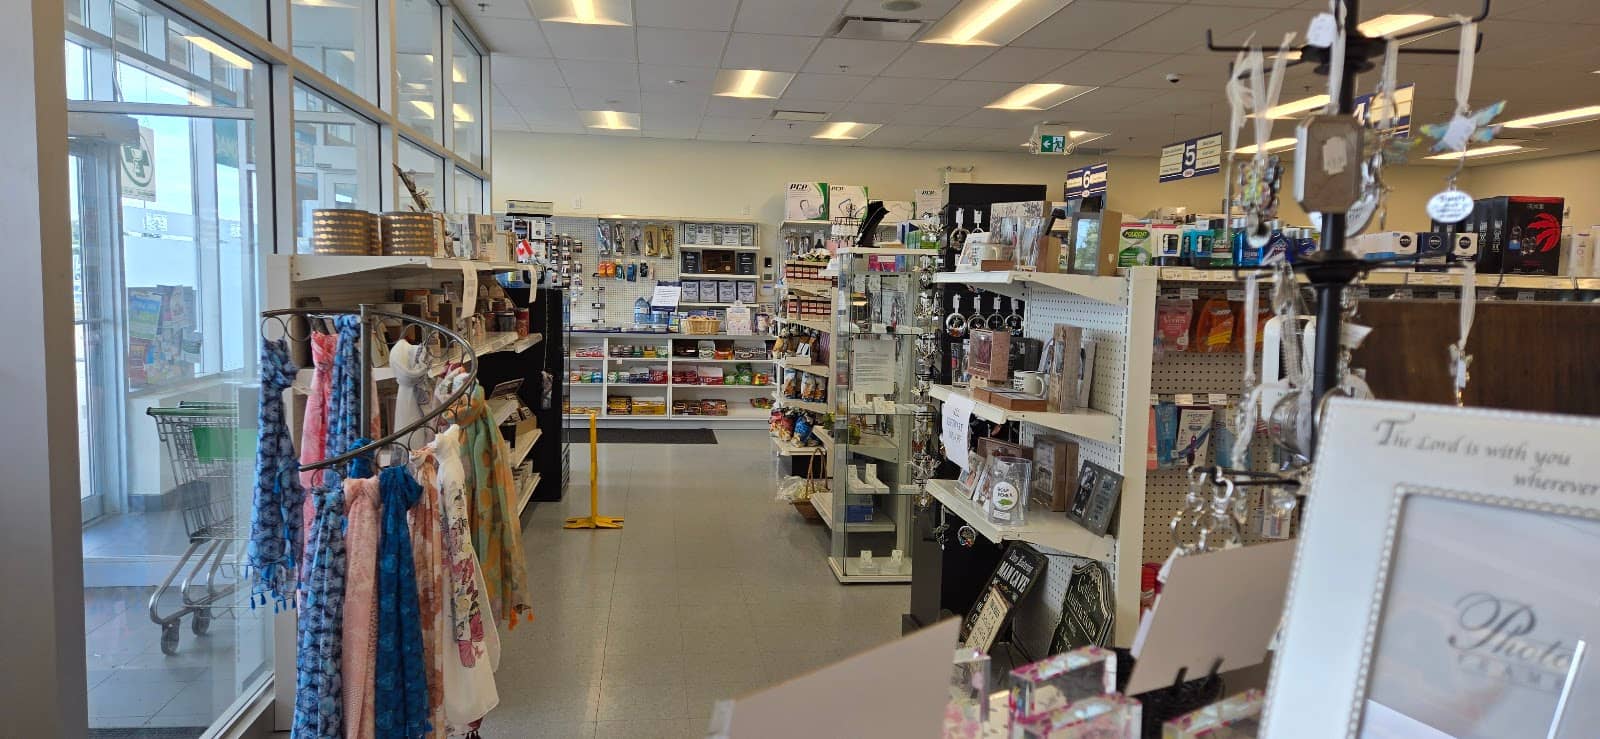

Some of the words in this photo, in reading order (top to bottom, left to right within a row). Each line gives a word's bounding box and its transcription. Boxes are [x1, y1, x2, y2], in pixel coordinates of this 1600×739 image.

[1184, 144, 1196, 166] 5
[789, 183, 808, 191] PCP
[1083, 170, 1091, 189] 6
[1374, 412, 1416, 448] The
[1416, 434, 1465, 454] Lord
[1466, 442, 1479, 457] is
[1485, 442, 1528, 461] with
[1530, 450, 1572, 473] you
[1513, 469, 1600, 497] wherever
[997, 560, 1016, 581] MAN
[1009, 570, 1031, 593] CAVE
[1448, 591, 1570, 668] Photo
